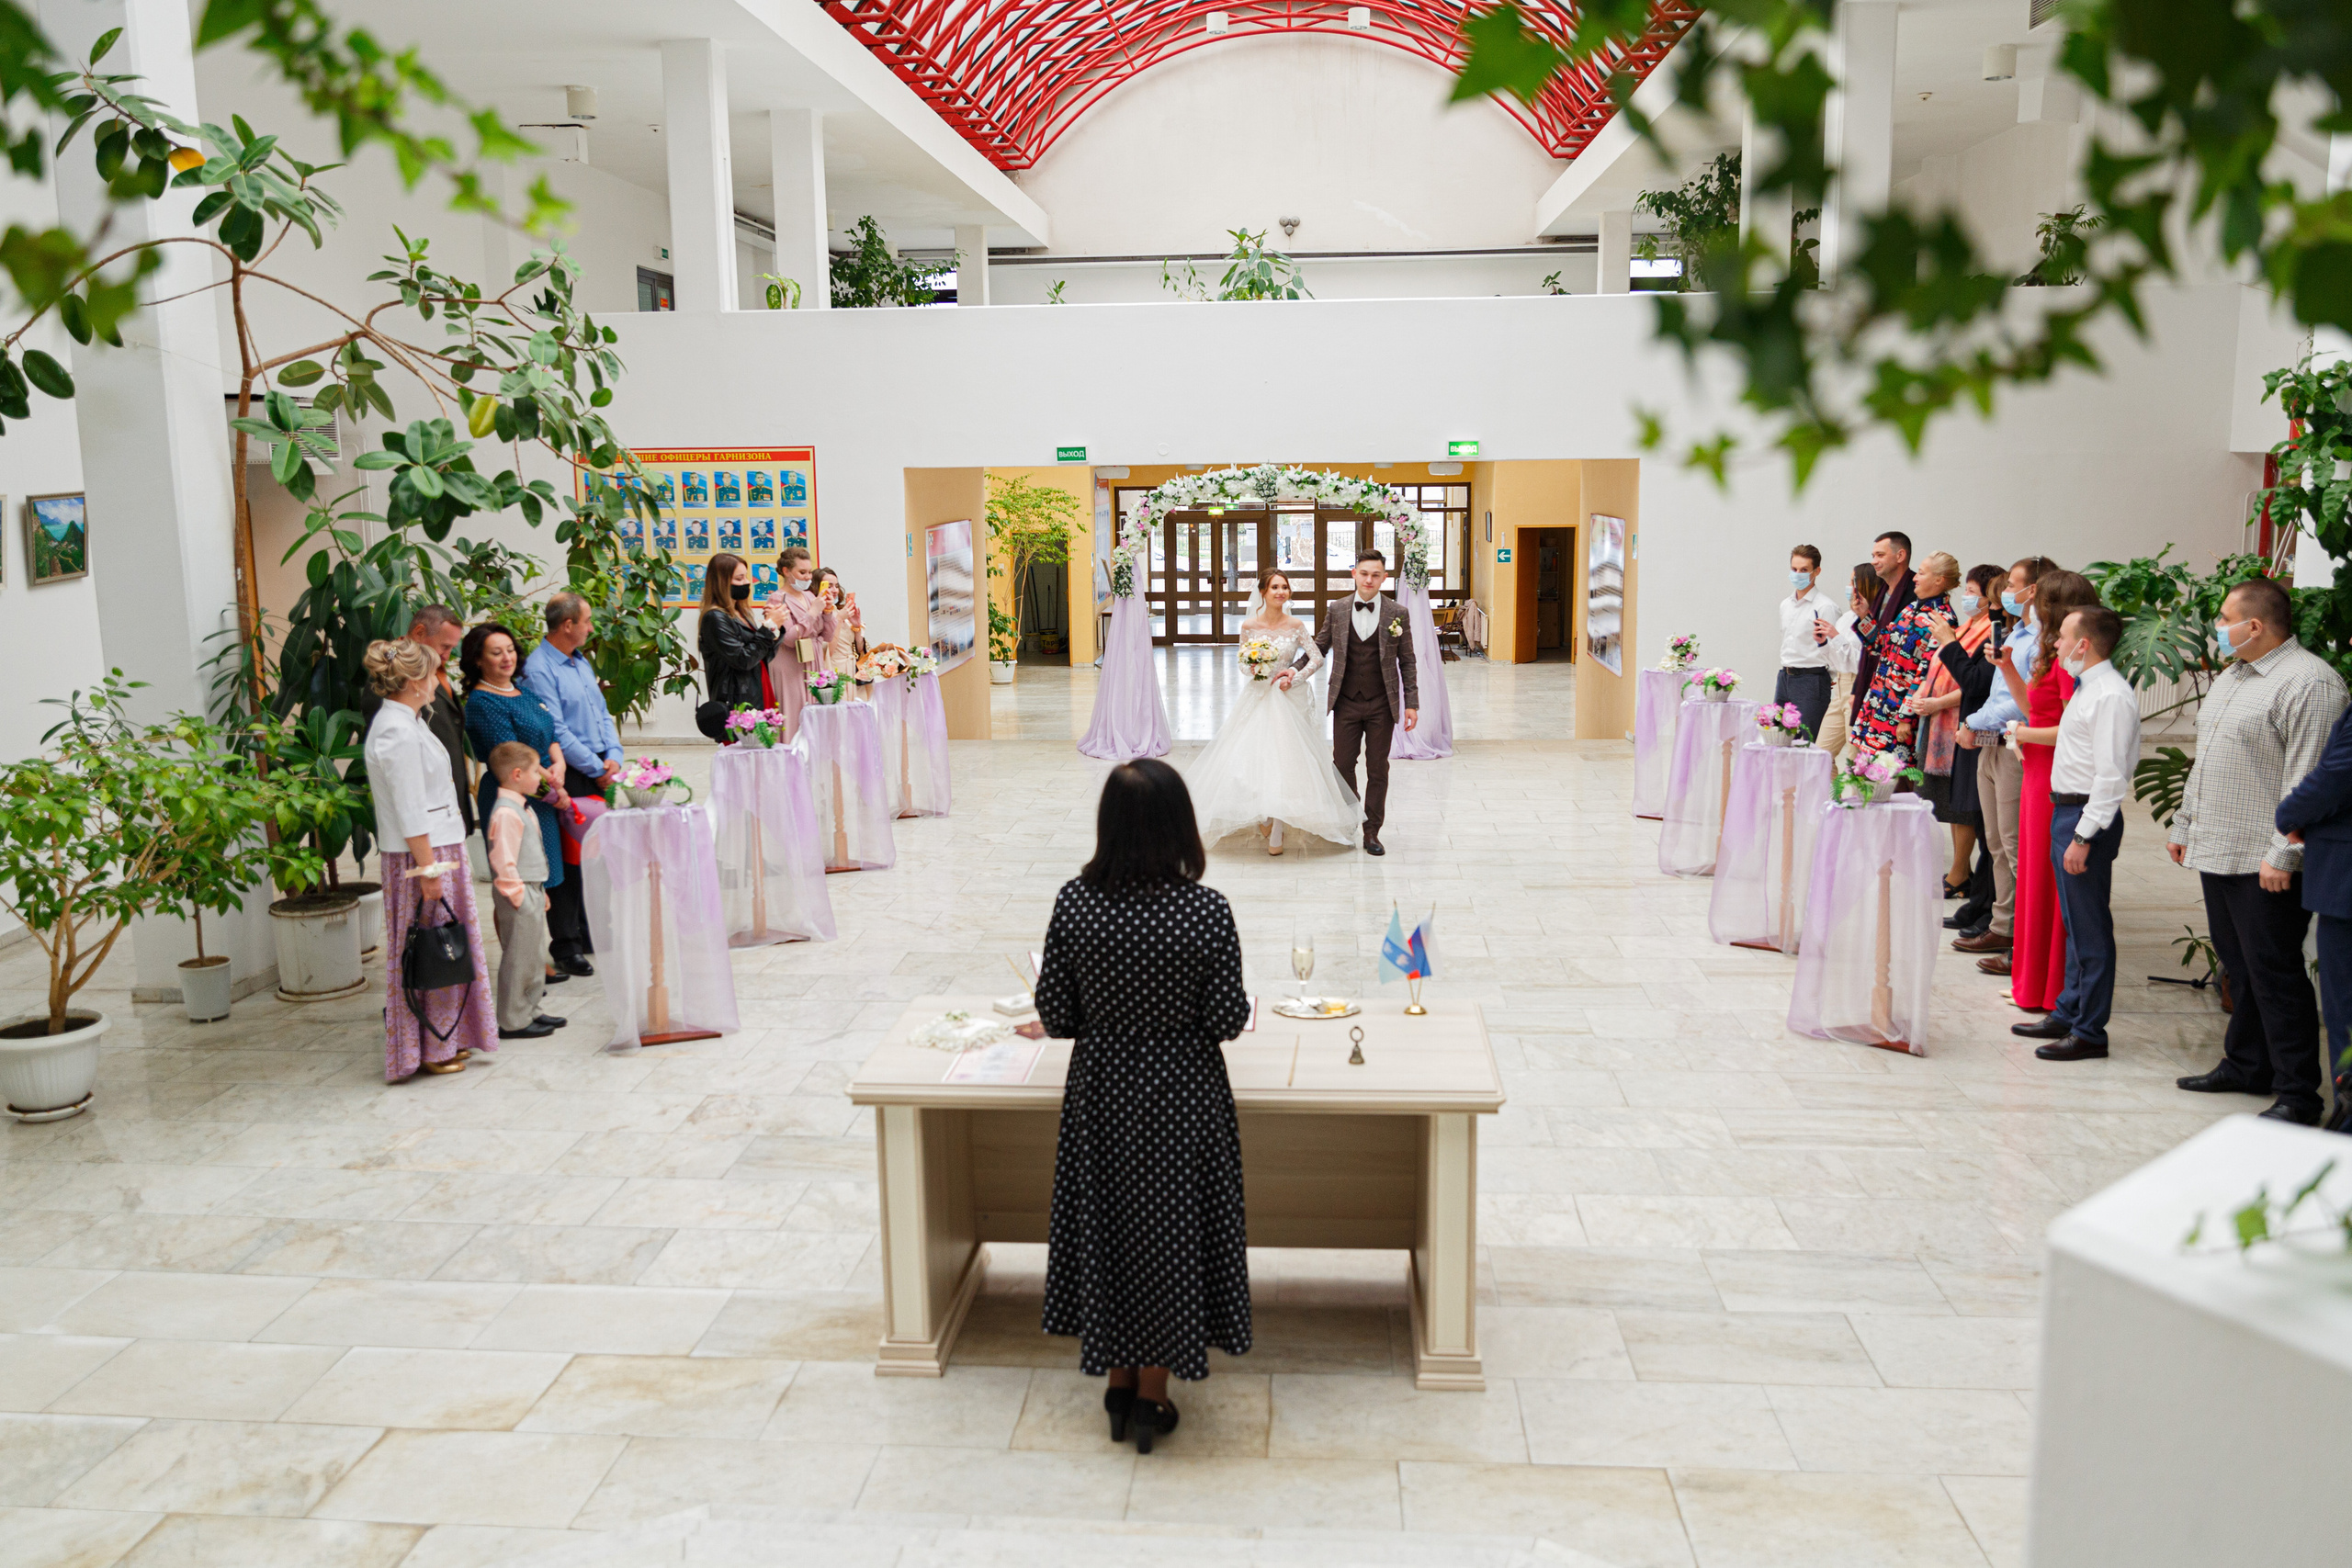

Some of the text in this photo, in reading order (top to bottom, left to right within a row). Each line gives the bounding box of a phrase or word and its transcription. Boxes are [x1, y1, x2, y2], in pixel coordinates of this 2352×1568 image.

[616, 452, 772, 462] ЛЧШИЕ ОФИЦЕРЫ ГАРНИЗОНА
[1058, 450, 1085, 458] ВЫХОД
